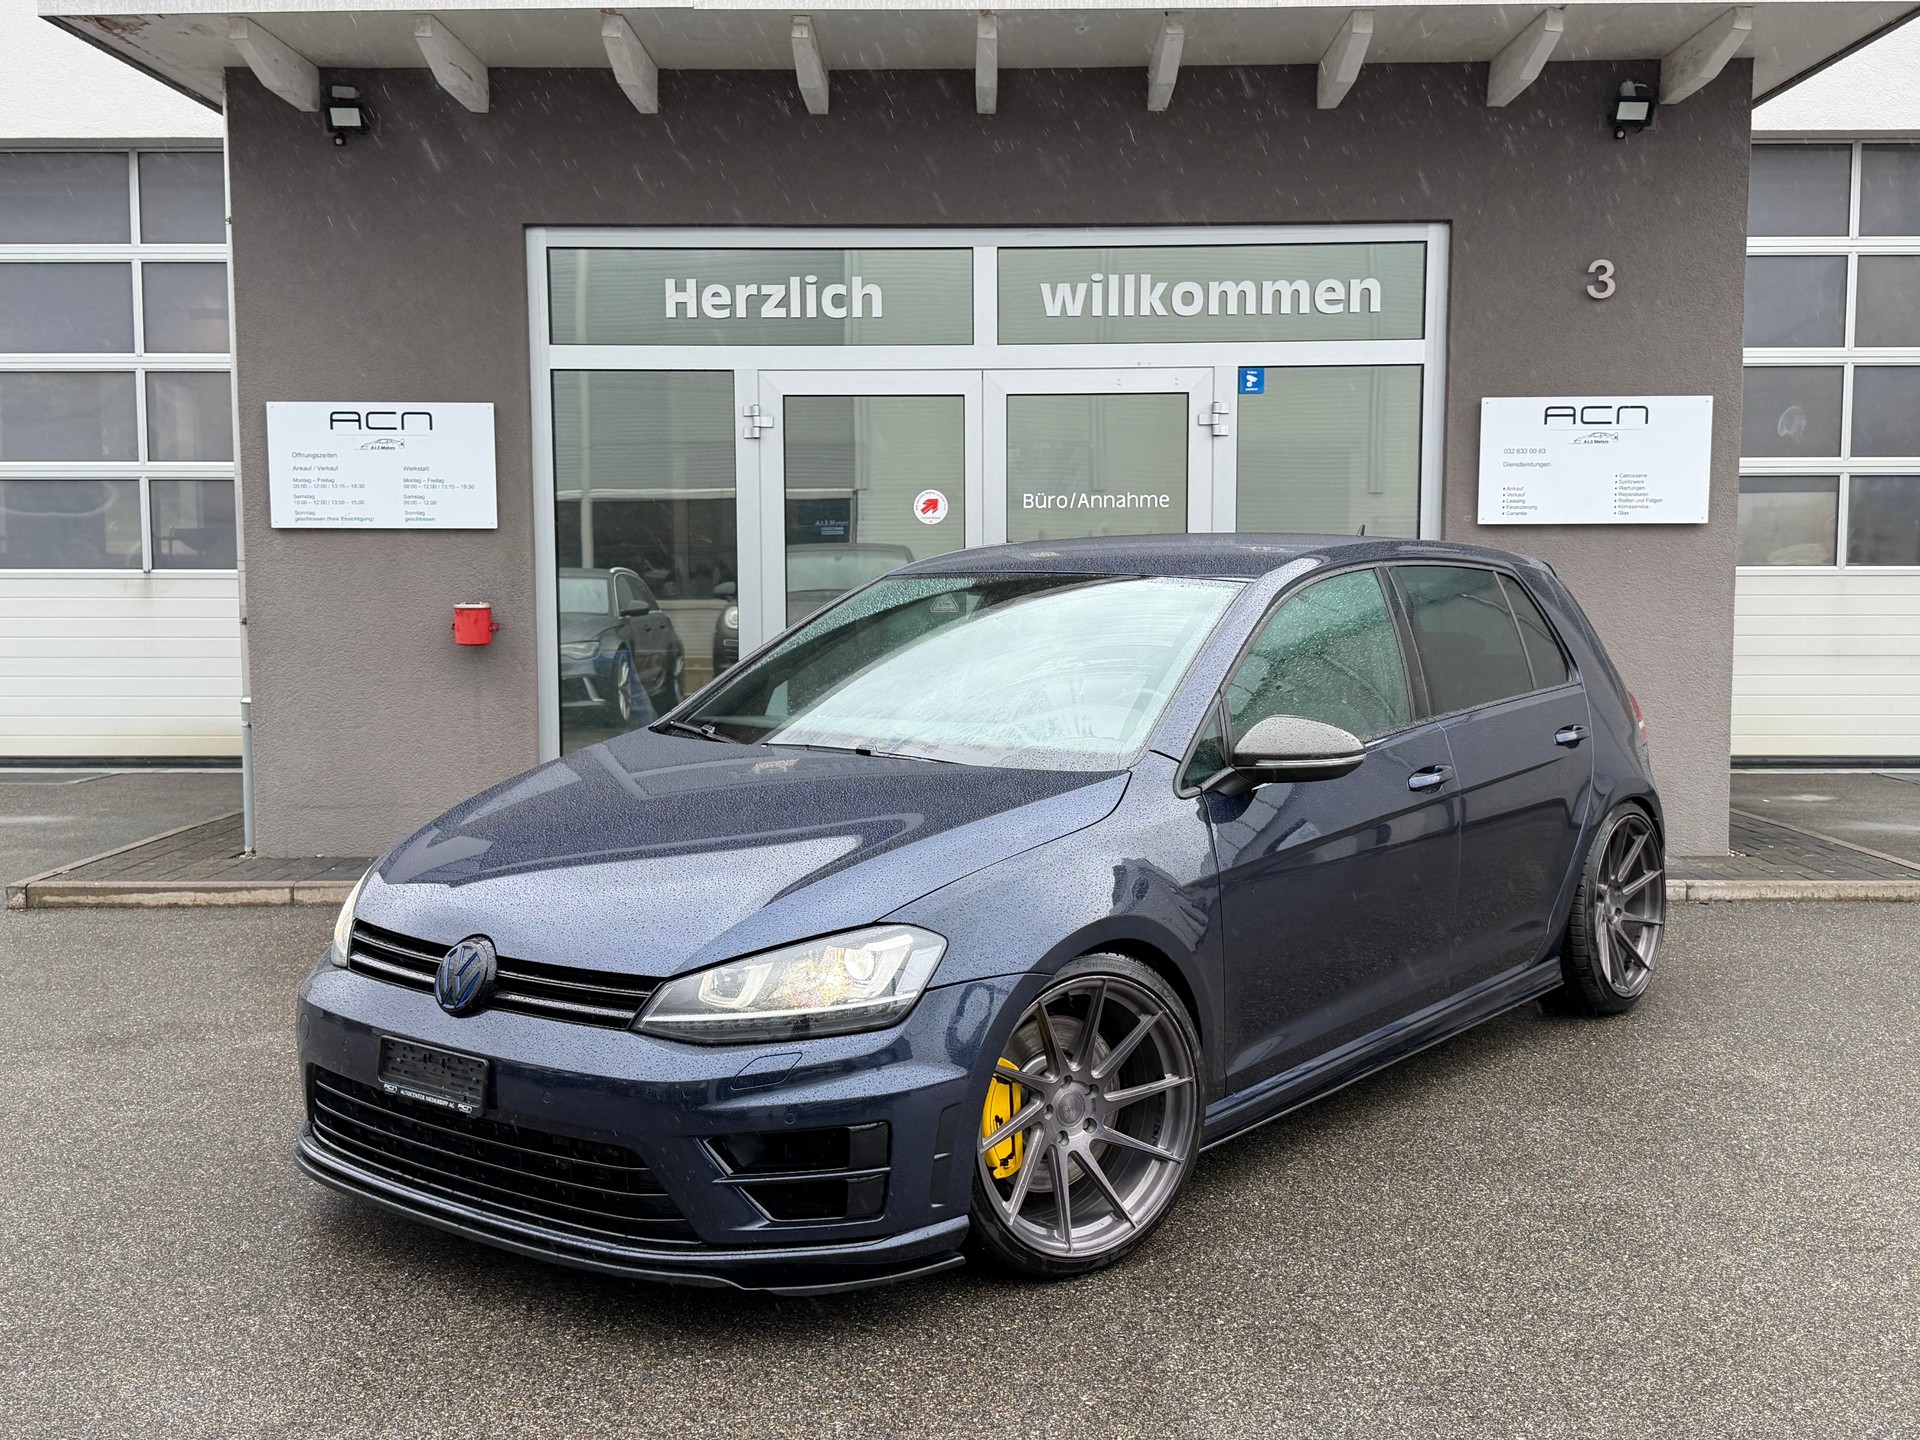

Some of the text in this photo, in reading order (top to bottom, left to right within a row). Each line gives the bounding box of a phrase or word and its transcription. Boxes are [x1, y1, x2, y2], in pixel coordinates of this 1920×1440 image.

[665, 273, 1381, 318] Herzlich willkommen
[1587, 259, 1616, 299] 3
[1023, 492, 1170, 508] Büro/Annahme
